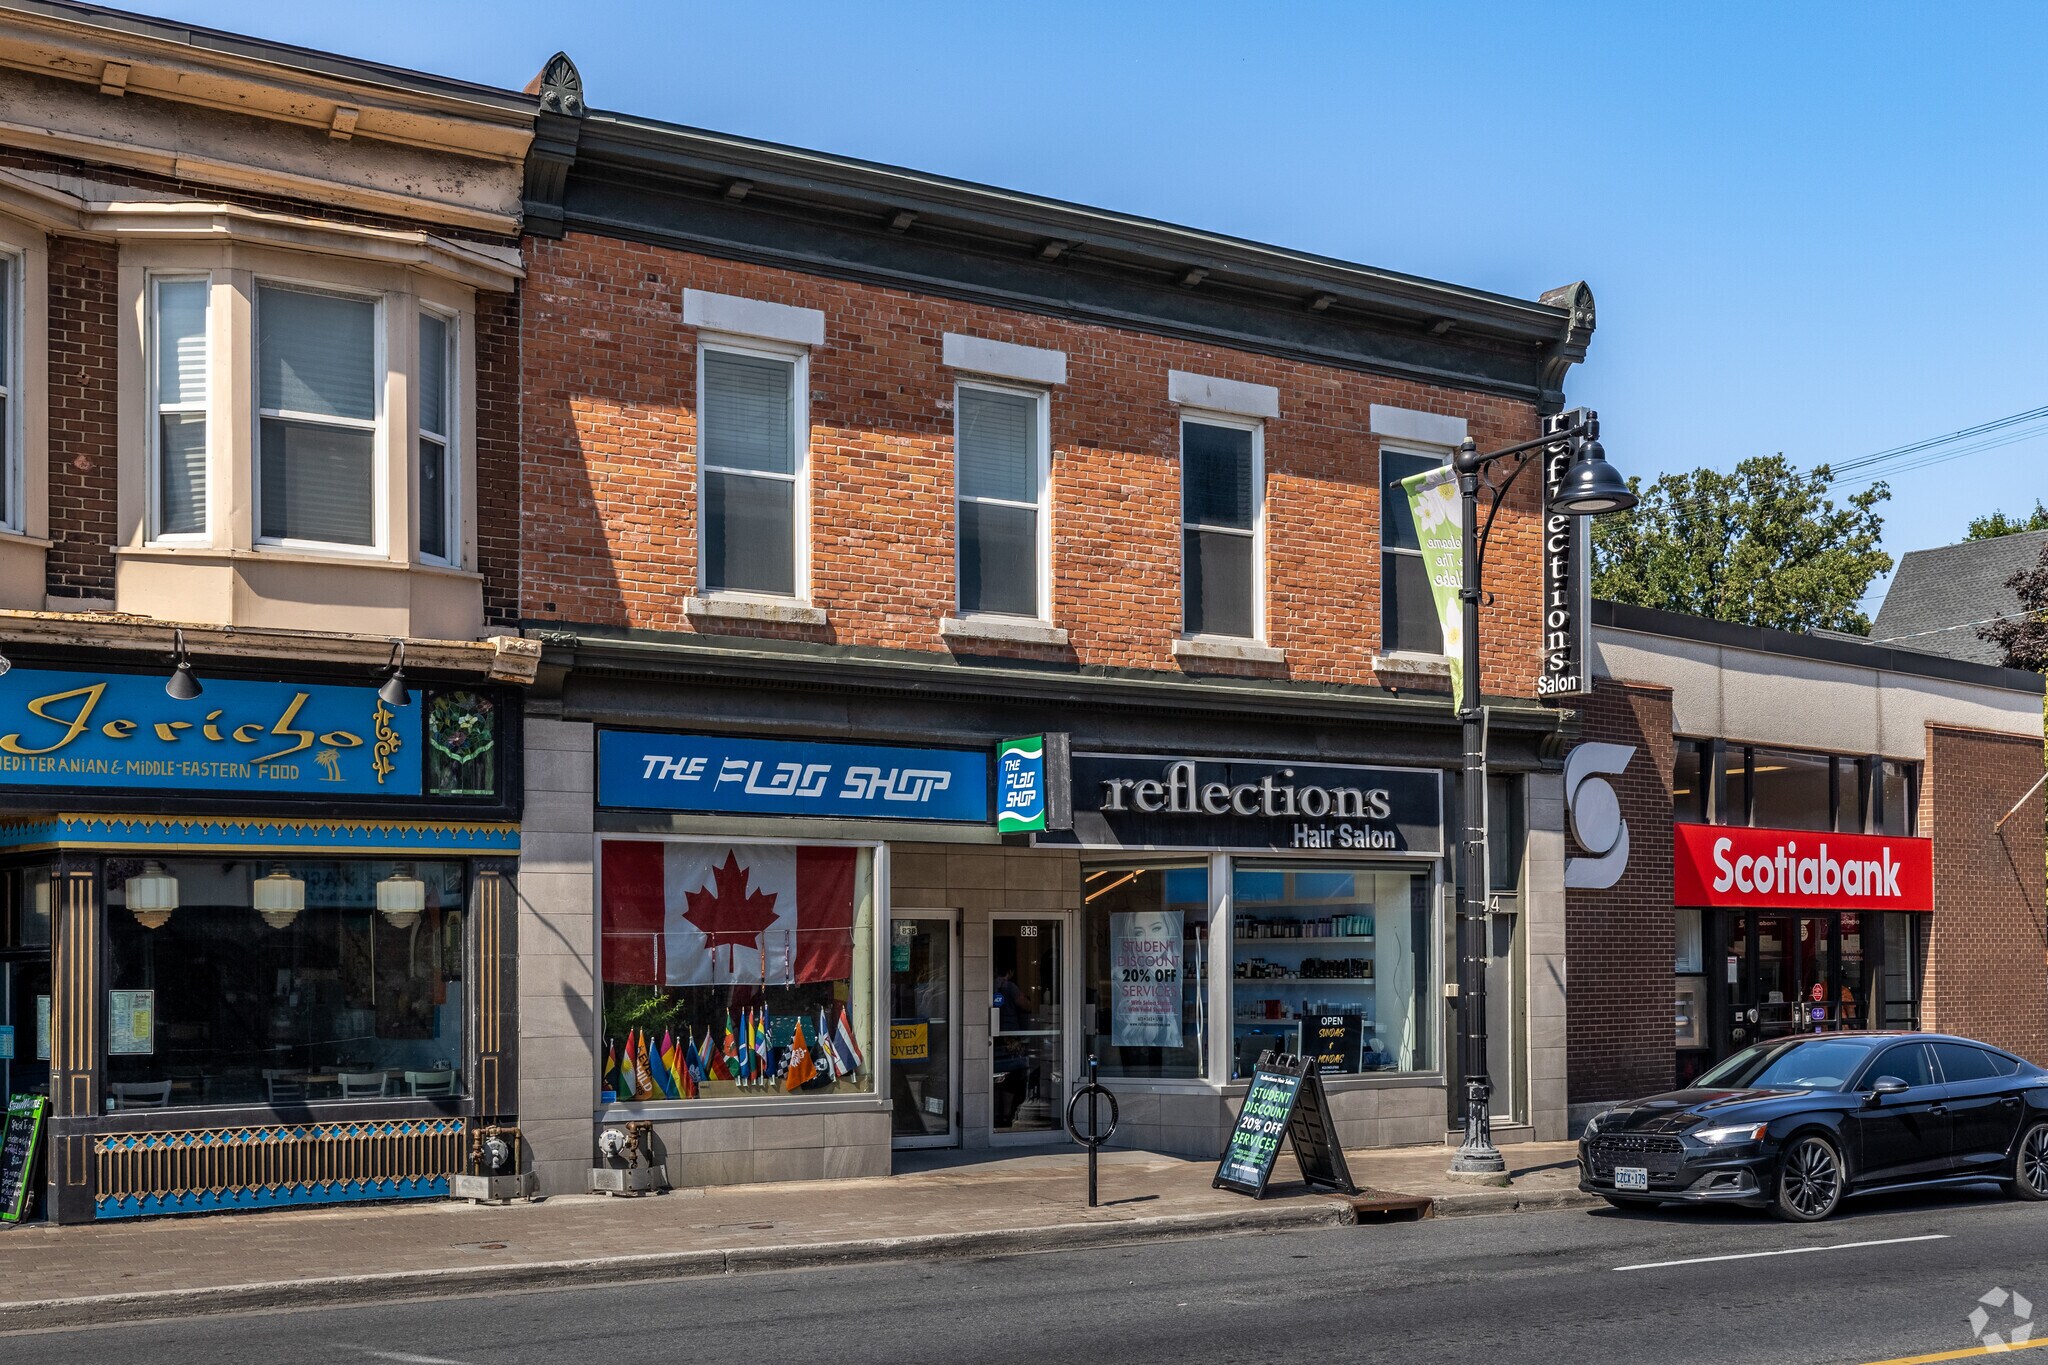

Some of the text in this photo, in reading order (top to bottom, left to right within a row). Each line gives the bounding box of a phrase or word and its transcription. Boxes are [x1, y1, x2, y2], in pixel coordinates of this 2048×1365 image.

[1537, 674, 1577, 695] Salon
[0, 682, 364, 764] Jericho
[111, 760, 124, 775] &
[258, 764, 300, 780] FOOD
[1004, 759, 1021, 772] THE
[642, 754, 709, 781] THE
[839, 765, 952, 802] SHOP
[1100, 760, 1391, 819] reflections
[1005, 790, 1036, 808] SHOP
[1291, 823, 1396, 849] Hair Salon
[1713, 837, 1902, 897] Scotiabank
[901, 927, 917, 935] 838
[1021, 926, 1037, 936] 836
[1122, 940, 1176, 953] STUDENT
[1117, 956, 1180, 968] DISCOUNT
[1122, 968, 1177, 983] 20% OFF
[1121, 985, 1177, 997] SERVICES
[1321, 1016, 1344, 1026] OPEN
[890, 1028, 917, 1039] OPEN
[1252, 1086, 1292, 1104] STUDENT
[1243, 1100, 1290, 1120] DISCOUNT
[1240, 1116, 1283, 1135] 20% OFF
[1232, 1130, 1278, 1151] SERVICES
[1634, 1173, 1646, 1185] 179
